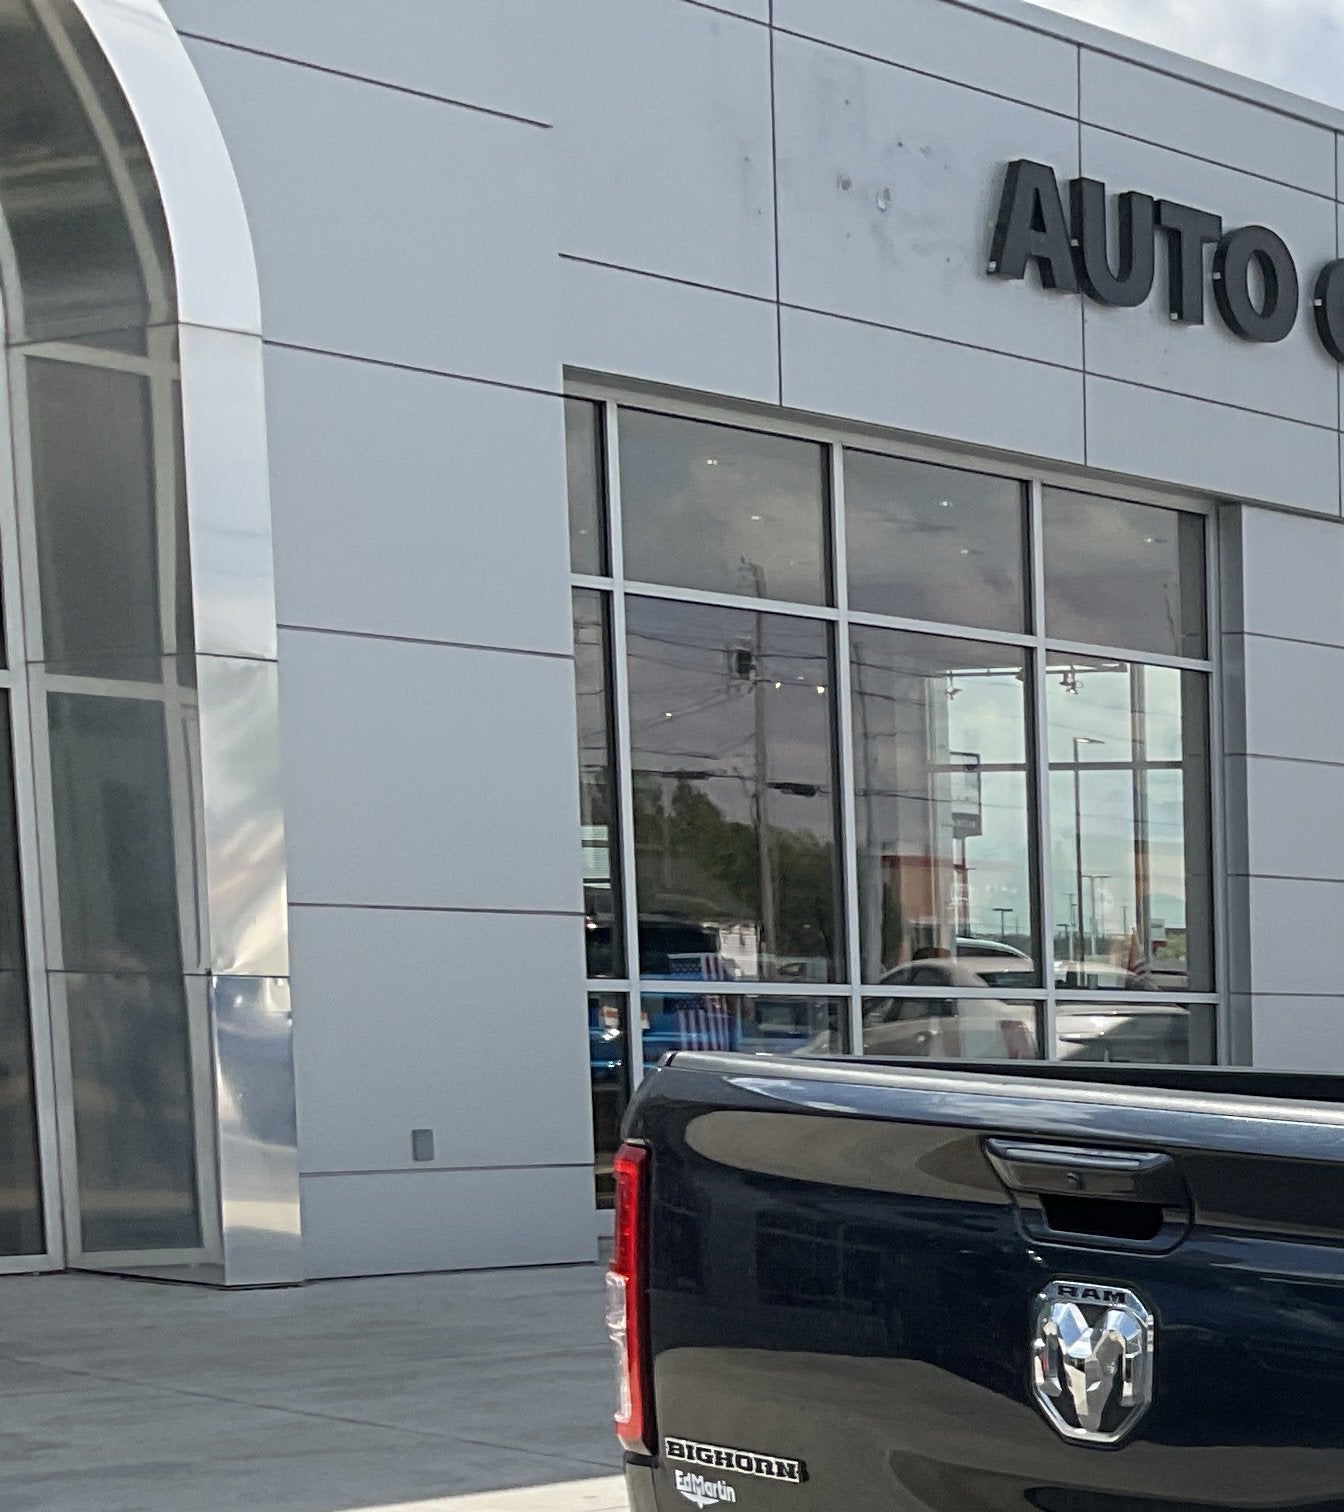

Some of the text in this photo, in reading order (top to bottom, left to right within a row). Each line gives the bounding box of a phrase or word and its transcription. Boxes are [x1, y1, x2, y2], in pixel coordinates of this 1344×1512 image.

[987, 159, 1298, 343] AUTO
[1057, 1285, 1126, 1303] RAM
[665, 1439, 799, 1481] BIGHORN
